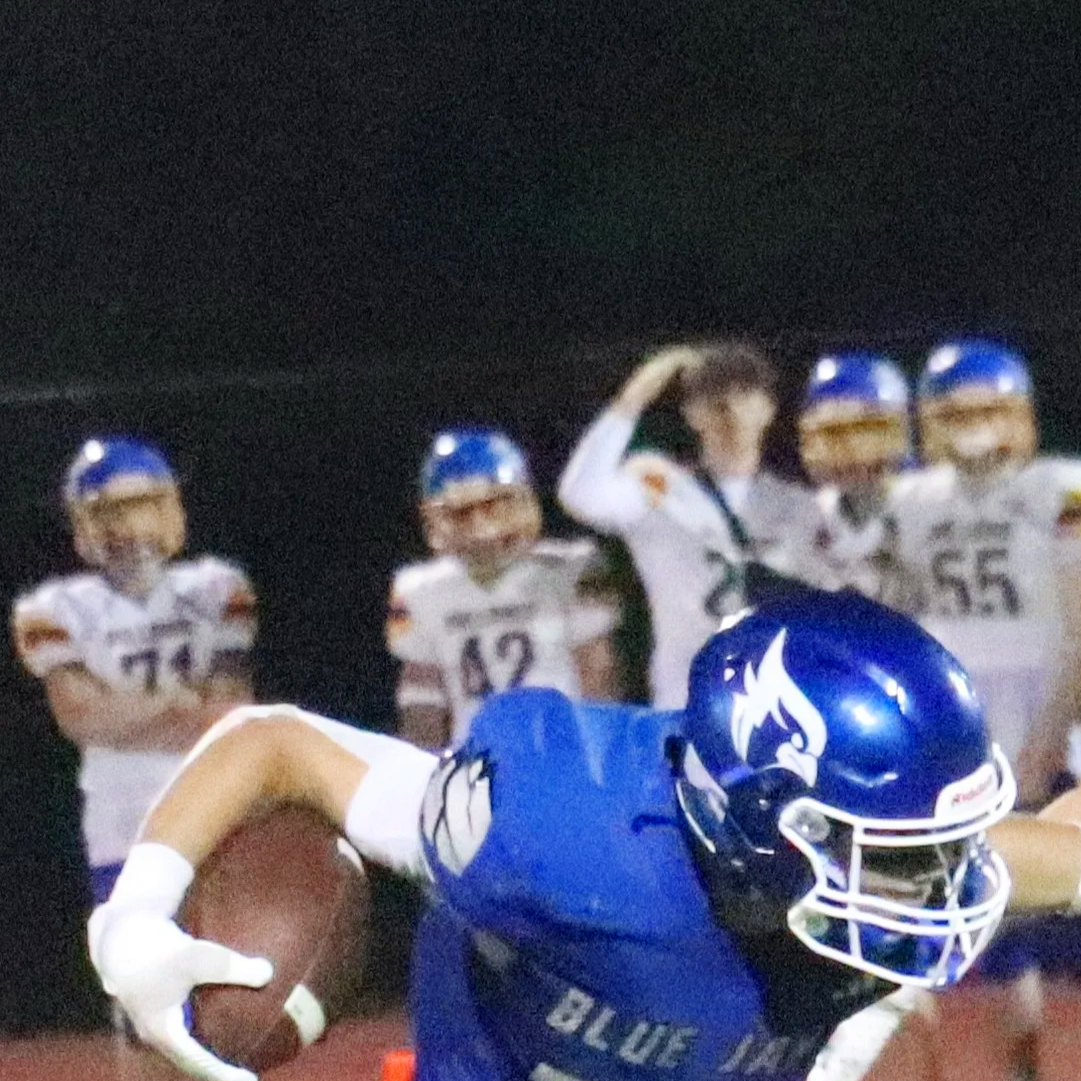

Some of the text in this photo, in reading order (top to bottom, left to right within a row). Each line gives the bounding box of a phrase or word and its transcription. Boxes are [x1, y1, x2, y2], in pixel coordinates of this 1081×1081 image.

[931, 549, 1021, 617] 55
[461, 632, 535, 698] 42
[546, 986, 698, 1068] BLUE
